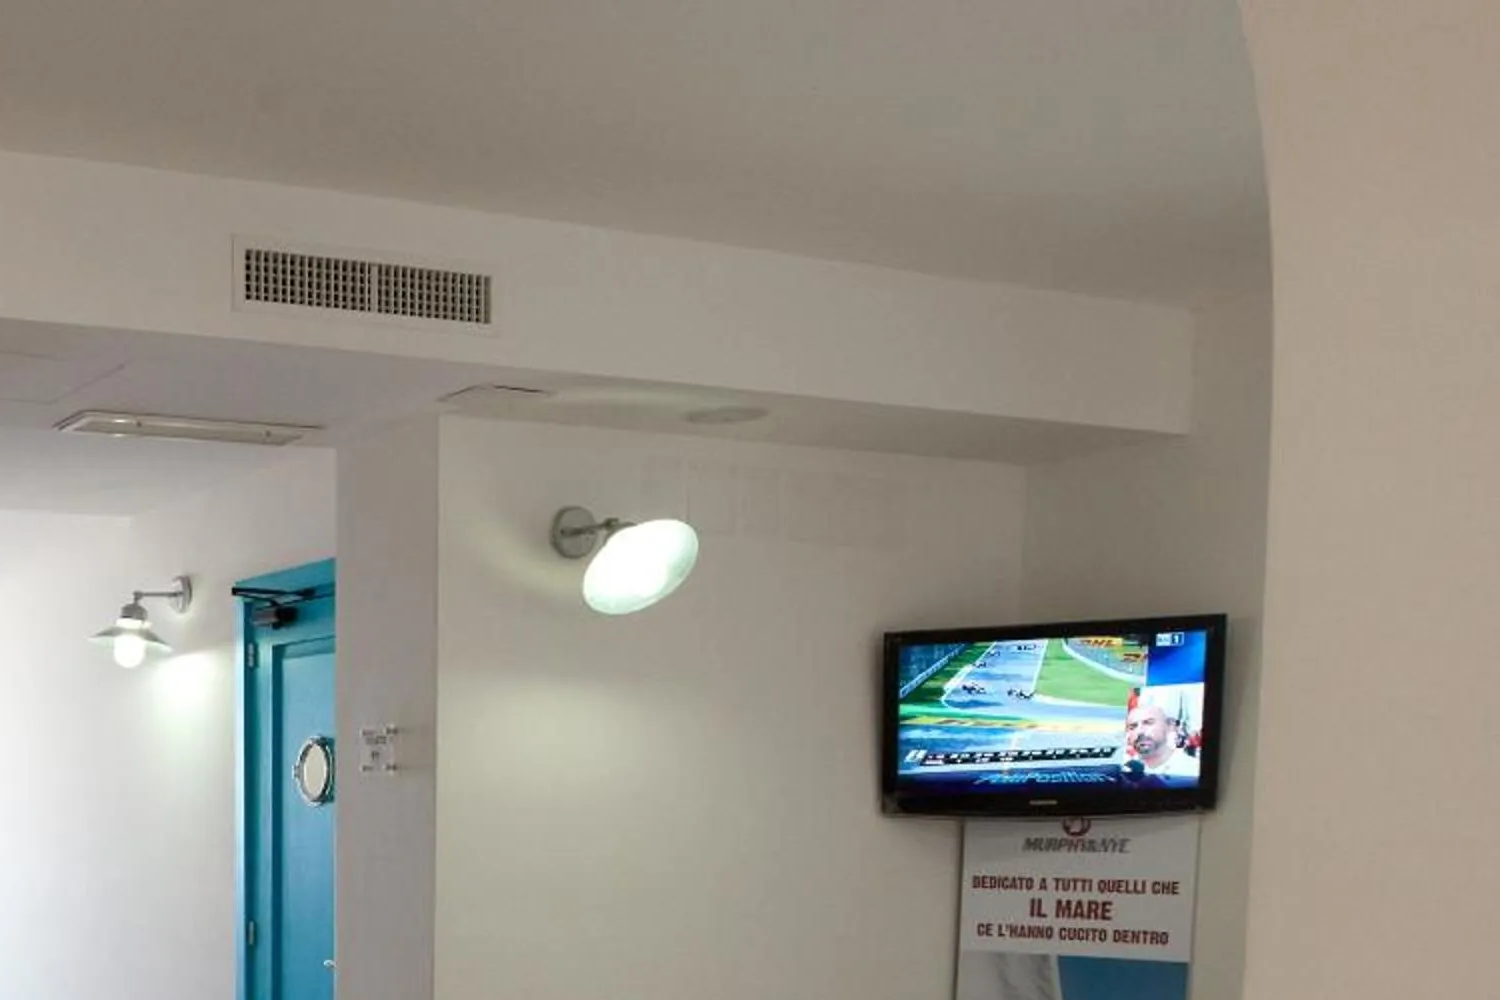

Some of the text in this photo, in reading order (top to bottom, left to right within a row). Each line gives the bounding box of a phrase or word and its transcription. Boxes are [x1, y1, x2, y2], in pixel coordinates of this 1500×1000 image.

[972, 875, 1180, 895] DEDICATO A TUTTI QUELLI CHE
[1030, 898, 1113, 920] IL MARE
[977, 923, 1169, 945] CE L'HANNO CUCITO DENTRO
